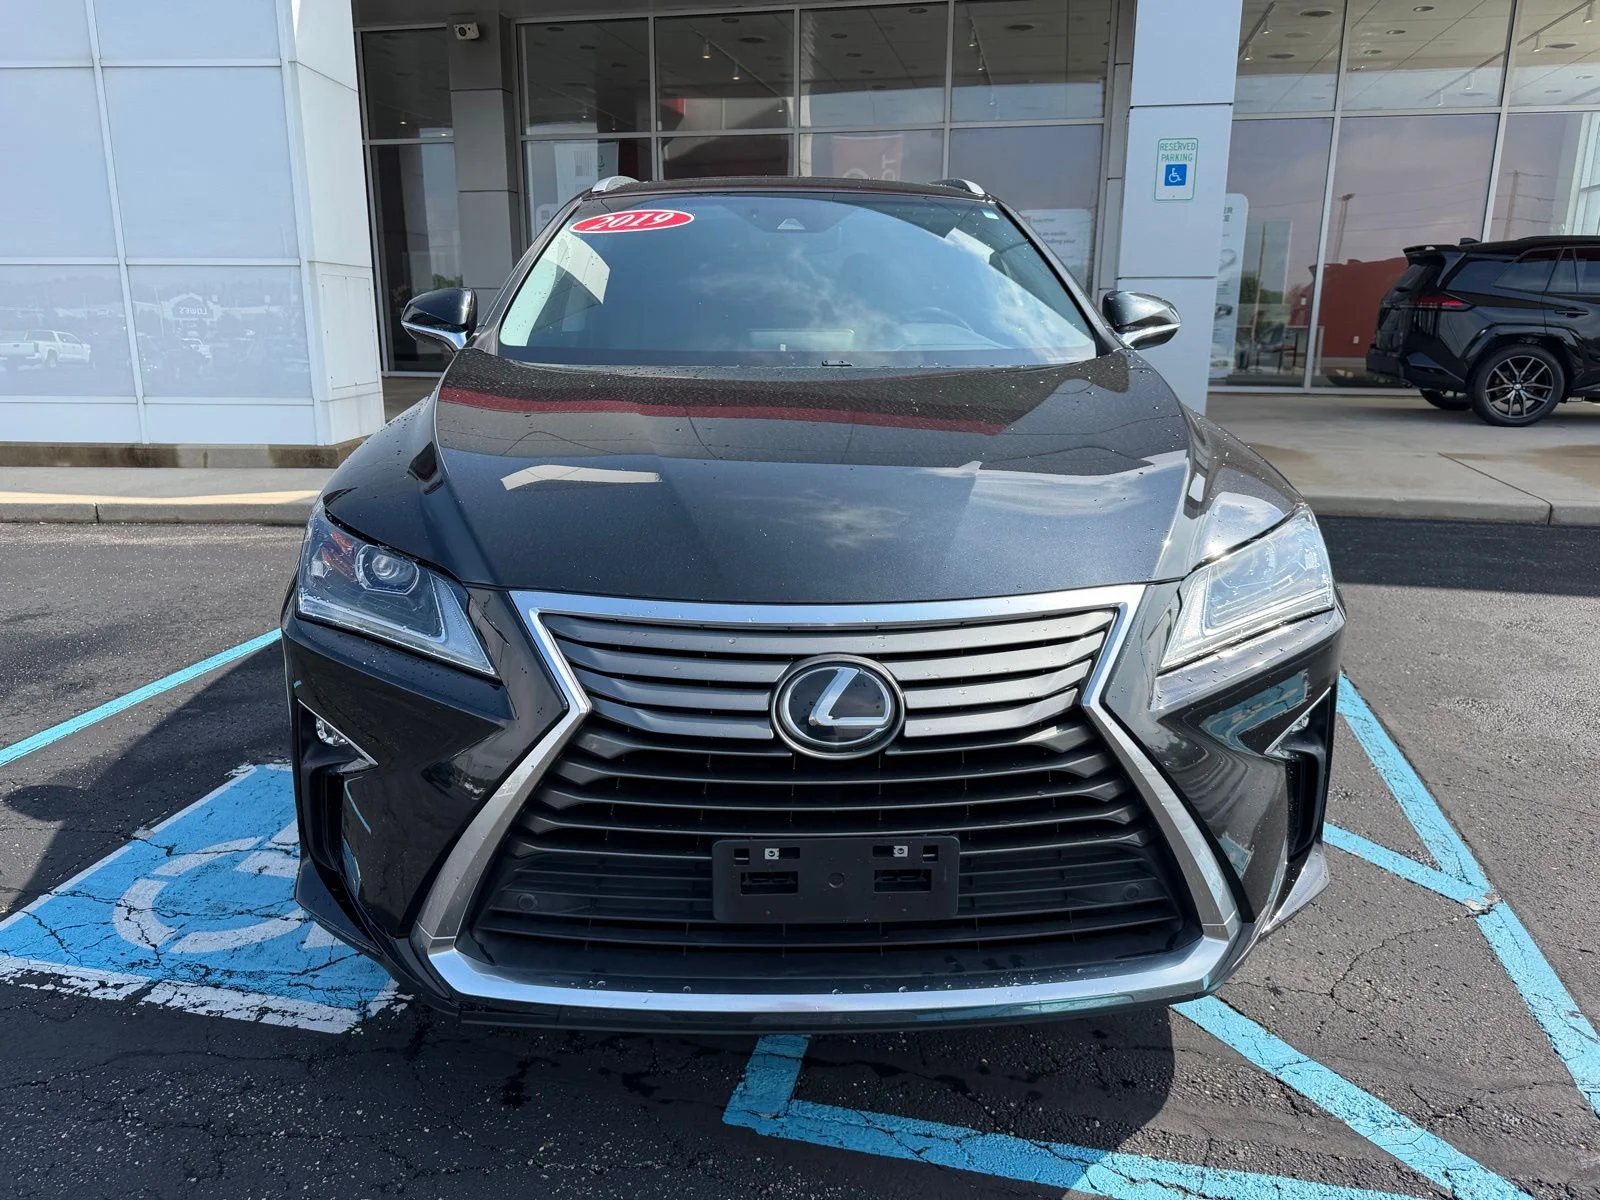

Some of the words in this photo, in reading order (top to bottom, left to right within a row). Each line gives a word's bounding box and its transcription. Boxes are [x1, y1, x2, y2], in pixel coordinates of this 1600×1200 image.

[1160, 142, 1196, 151] RESERVED
[1161, 153, 1193, 162] PARKING
[585, 212, 675, 231] 2019
